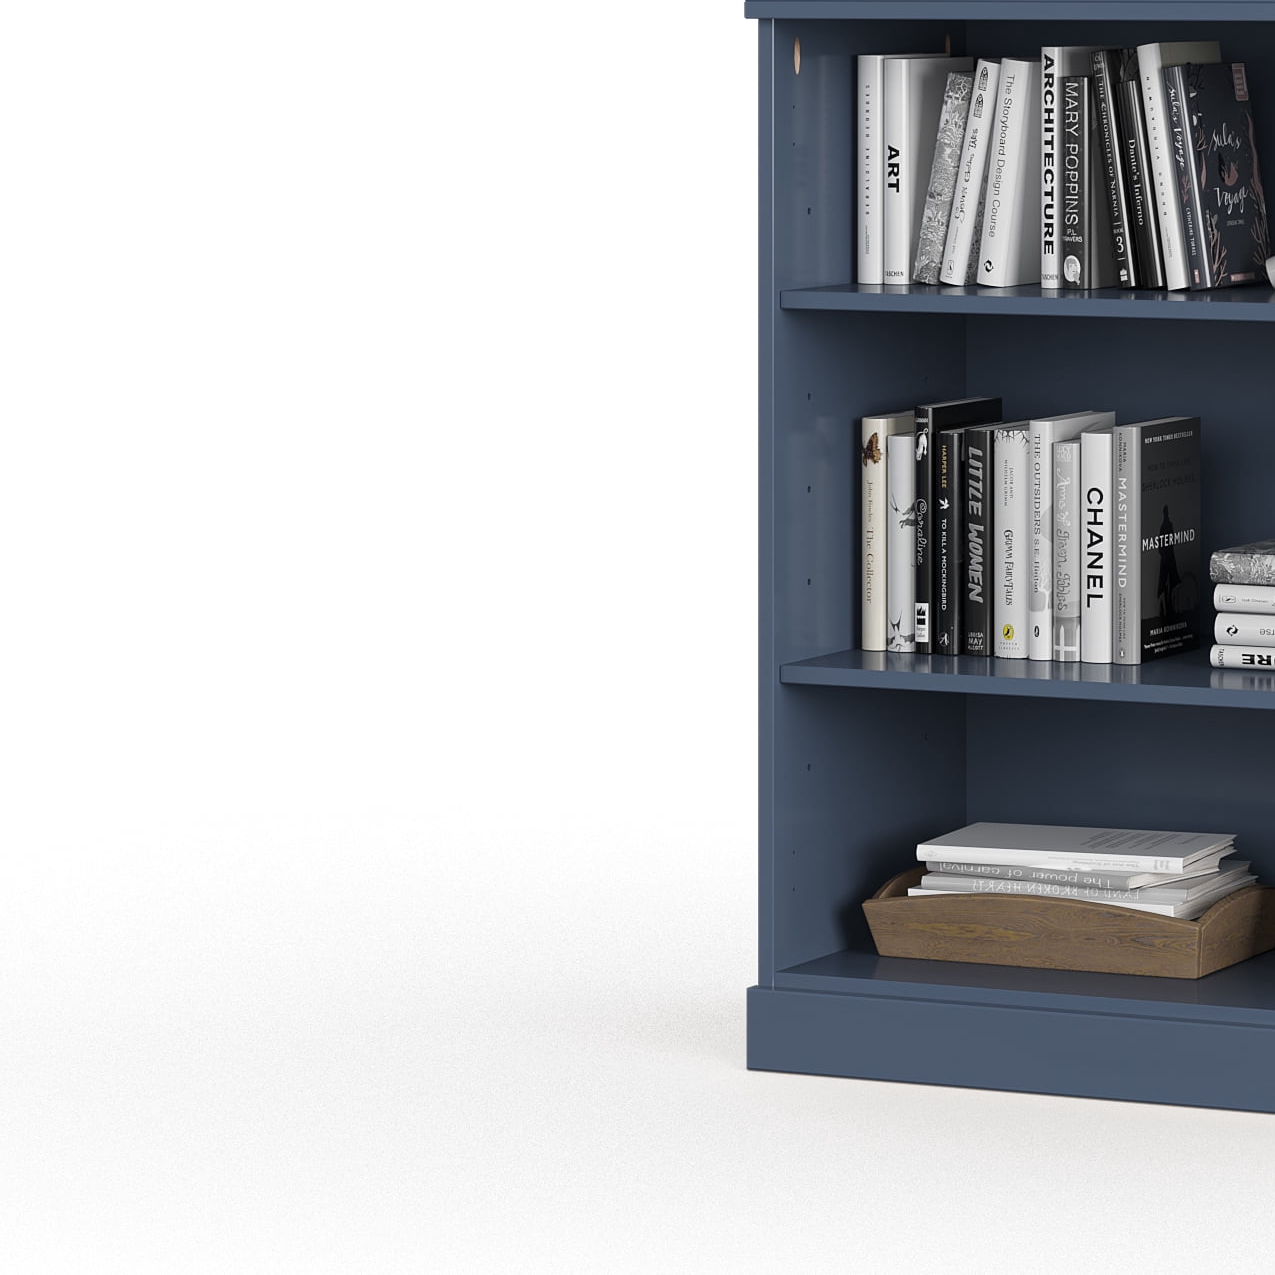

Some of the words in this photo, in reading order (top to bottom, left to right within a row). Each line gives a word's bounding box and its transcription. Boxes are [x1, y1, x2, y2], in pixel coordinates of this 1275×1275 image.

[1004, 74, 1016, 95] The
[997, 97, 1013, 156] Storyboard
[1065, 82, 1079, 136] MARY
[1101, 101, 1113, 164] CHRONICLES
[1174, 127, 1185, 169] Voyage
[887, 145, 900, 193] ART
[1043, 53, 1055, 255] ARCHITECTURE
[1108, 166, 1114, 177] OF
[1128, 139, 1140, 181] Dante's
[992, 159, 1006, 196] Design
[1065, 143, 1079, 225] POPPINS
[1110, 179, 1119, 217] NARNIA
[1133, 184, 1145, 226] Inferno
[1214, 186, 1249, 215] Voyage
[988, 199, 1001, 237] Course
[1115, 236, 1124, 253] 3
[1033, 433, 1041, 459] THE
[968, 446, 984, 517] LITTLE
[1033, 461, 1041, 535] OUTSIDERS
[866, 526, 874, 549] The
[915, 498, 928, 566] Coraline
[941, 518, 947, 530] TO
[1117, 477, 1127, 588] MASTERMIND
[1142, 528, 1195, 551] MASTERMIND
[1003, 529, 1014, 559] GRIMM
[1086, 487, 1104, 608] CHANEL
[865, 553, 875, 604] Collector
[967, 523, 985, 604] WOMEN
[1032, 561, 1040, 593] Hinton
[939, 862, 1000, 876] carnival
[1007, 867, 1023, 878] of
[1031, 870, 1079, 883] power
[1083, 878, 1113, 889] The
